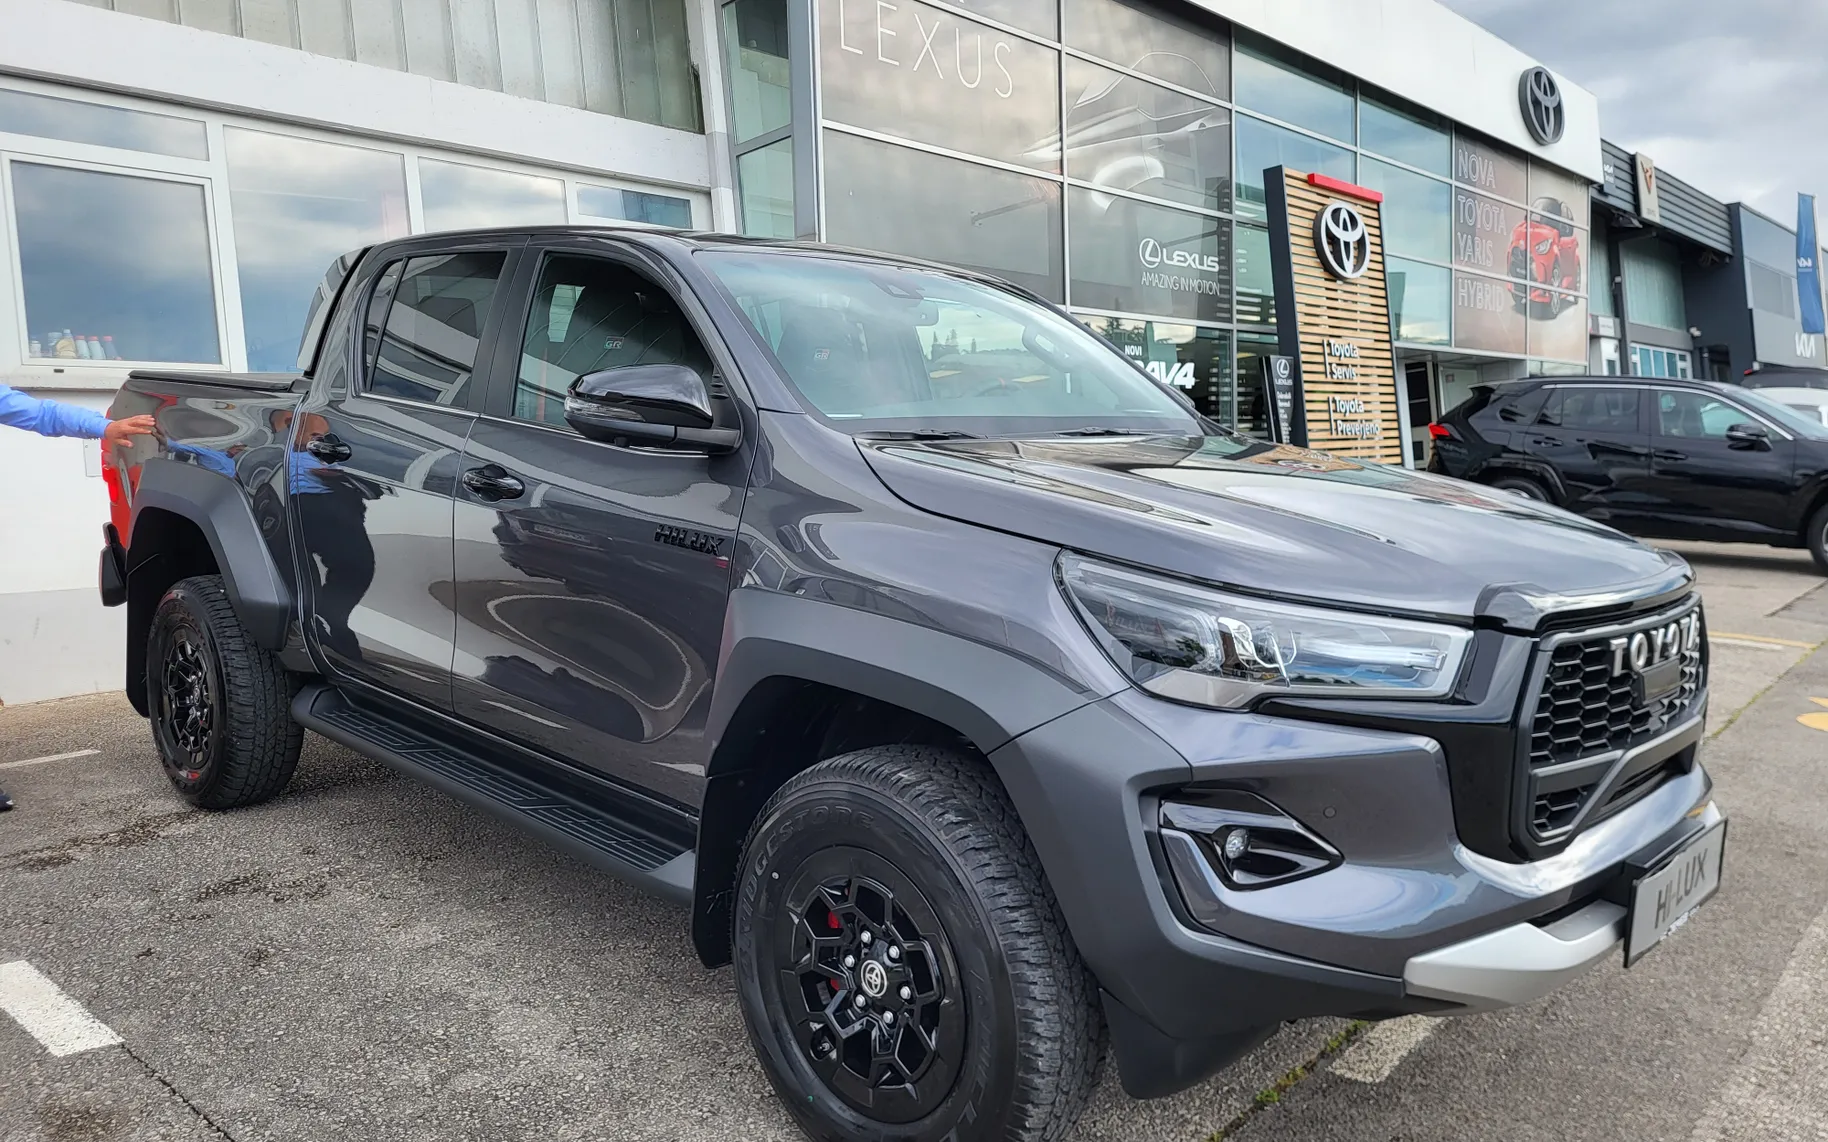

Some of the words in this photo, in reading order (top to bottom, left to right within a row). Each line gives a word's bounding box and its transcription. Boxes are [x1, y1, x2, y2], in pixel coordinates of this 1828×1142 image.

[839, 0, 1013, 98] LEXUS
[1458, 149, 1496, 189] NOVA
[1457, 194, 1507, 236] TOYOTA
[1163, 247, 1219, 272] LEXUS
[1457, 231, 1494, 267] YARIS
[1141, 271, 1180, 291] AMAZING
[1180, 276, 1189, 292] IN
[1189, 278, 1220, 296] MOTION
[1458, 278, 1504, 312] HYBRID
[1124, 344, 1143, 357] NOVI
[1329, 339, 1360, 360] Toyota
[1134, 360, 1196, 389] AV4
[1331, 363, 1357, 380] Servis
[1333, 396, 1365, 417] Toyota
[1336, 419, 1380, 440] Preverjeno
[654, 524, 725, 556] HILUX
[1610, 606, 1700, 678] TOYOTA
[1654, 847, 1708, 930] HI-LUX
